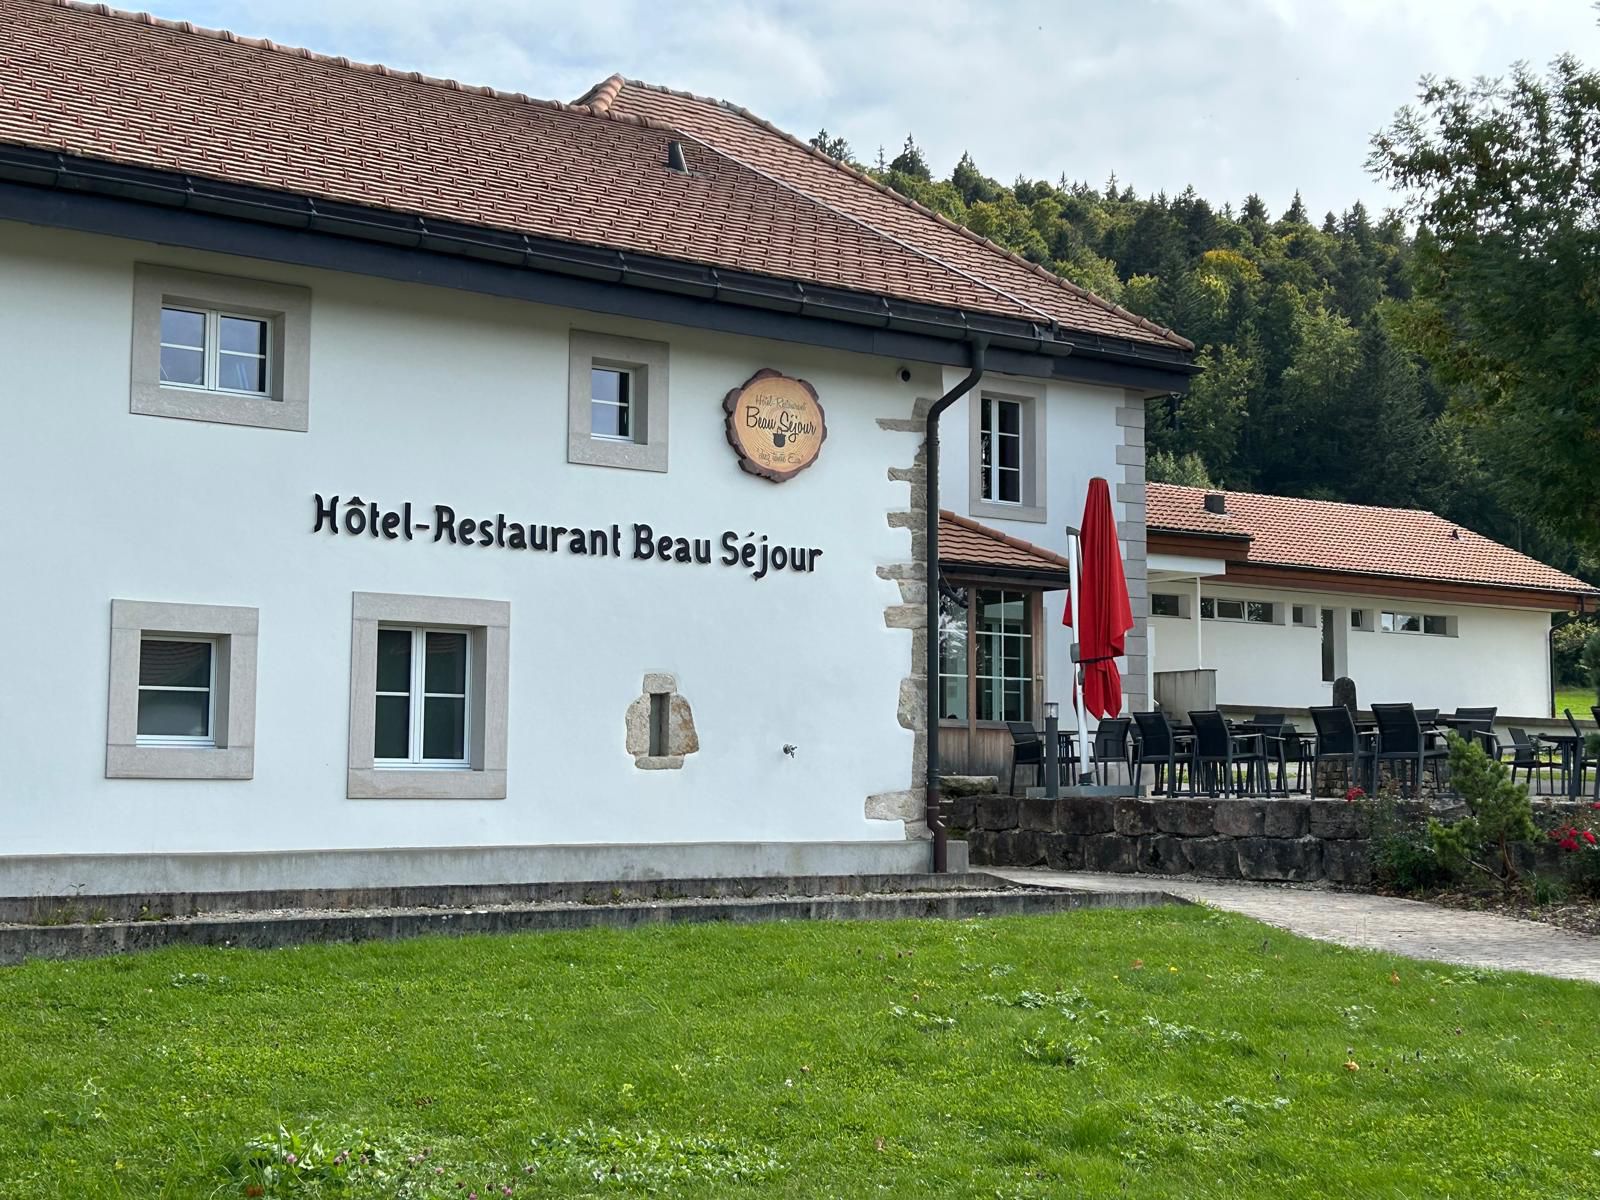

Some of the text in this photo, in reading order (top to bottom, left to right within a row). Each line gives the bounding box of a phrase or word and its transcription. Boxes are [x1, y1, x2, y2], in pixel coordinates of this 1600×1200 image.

[746, 405, 816, 443] Beau Séjour
[313, 493, 823, 580] Hôtel-Restaurant Beau Séjour
